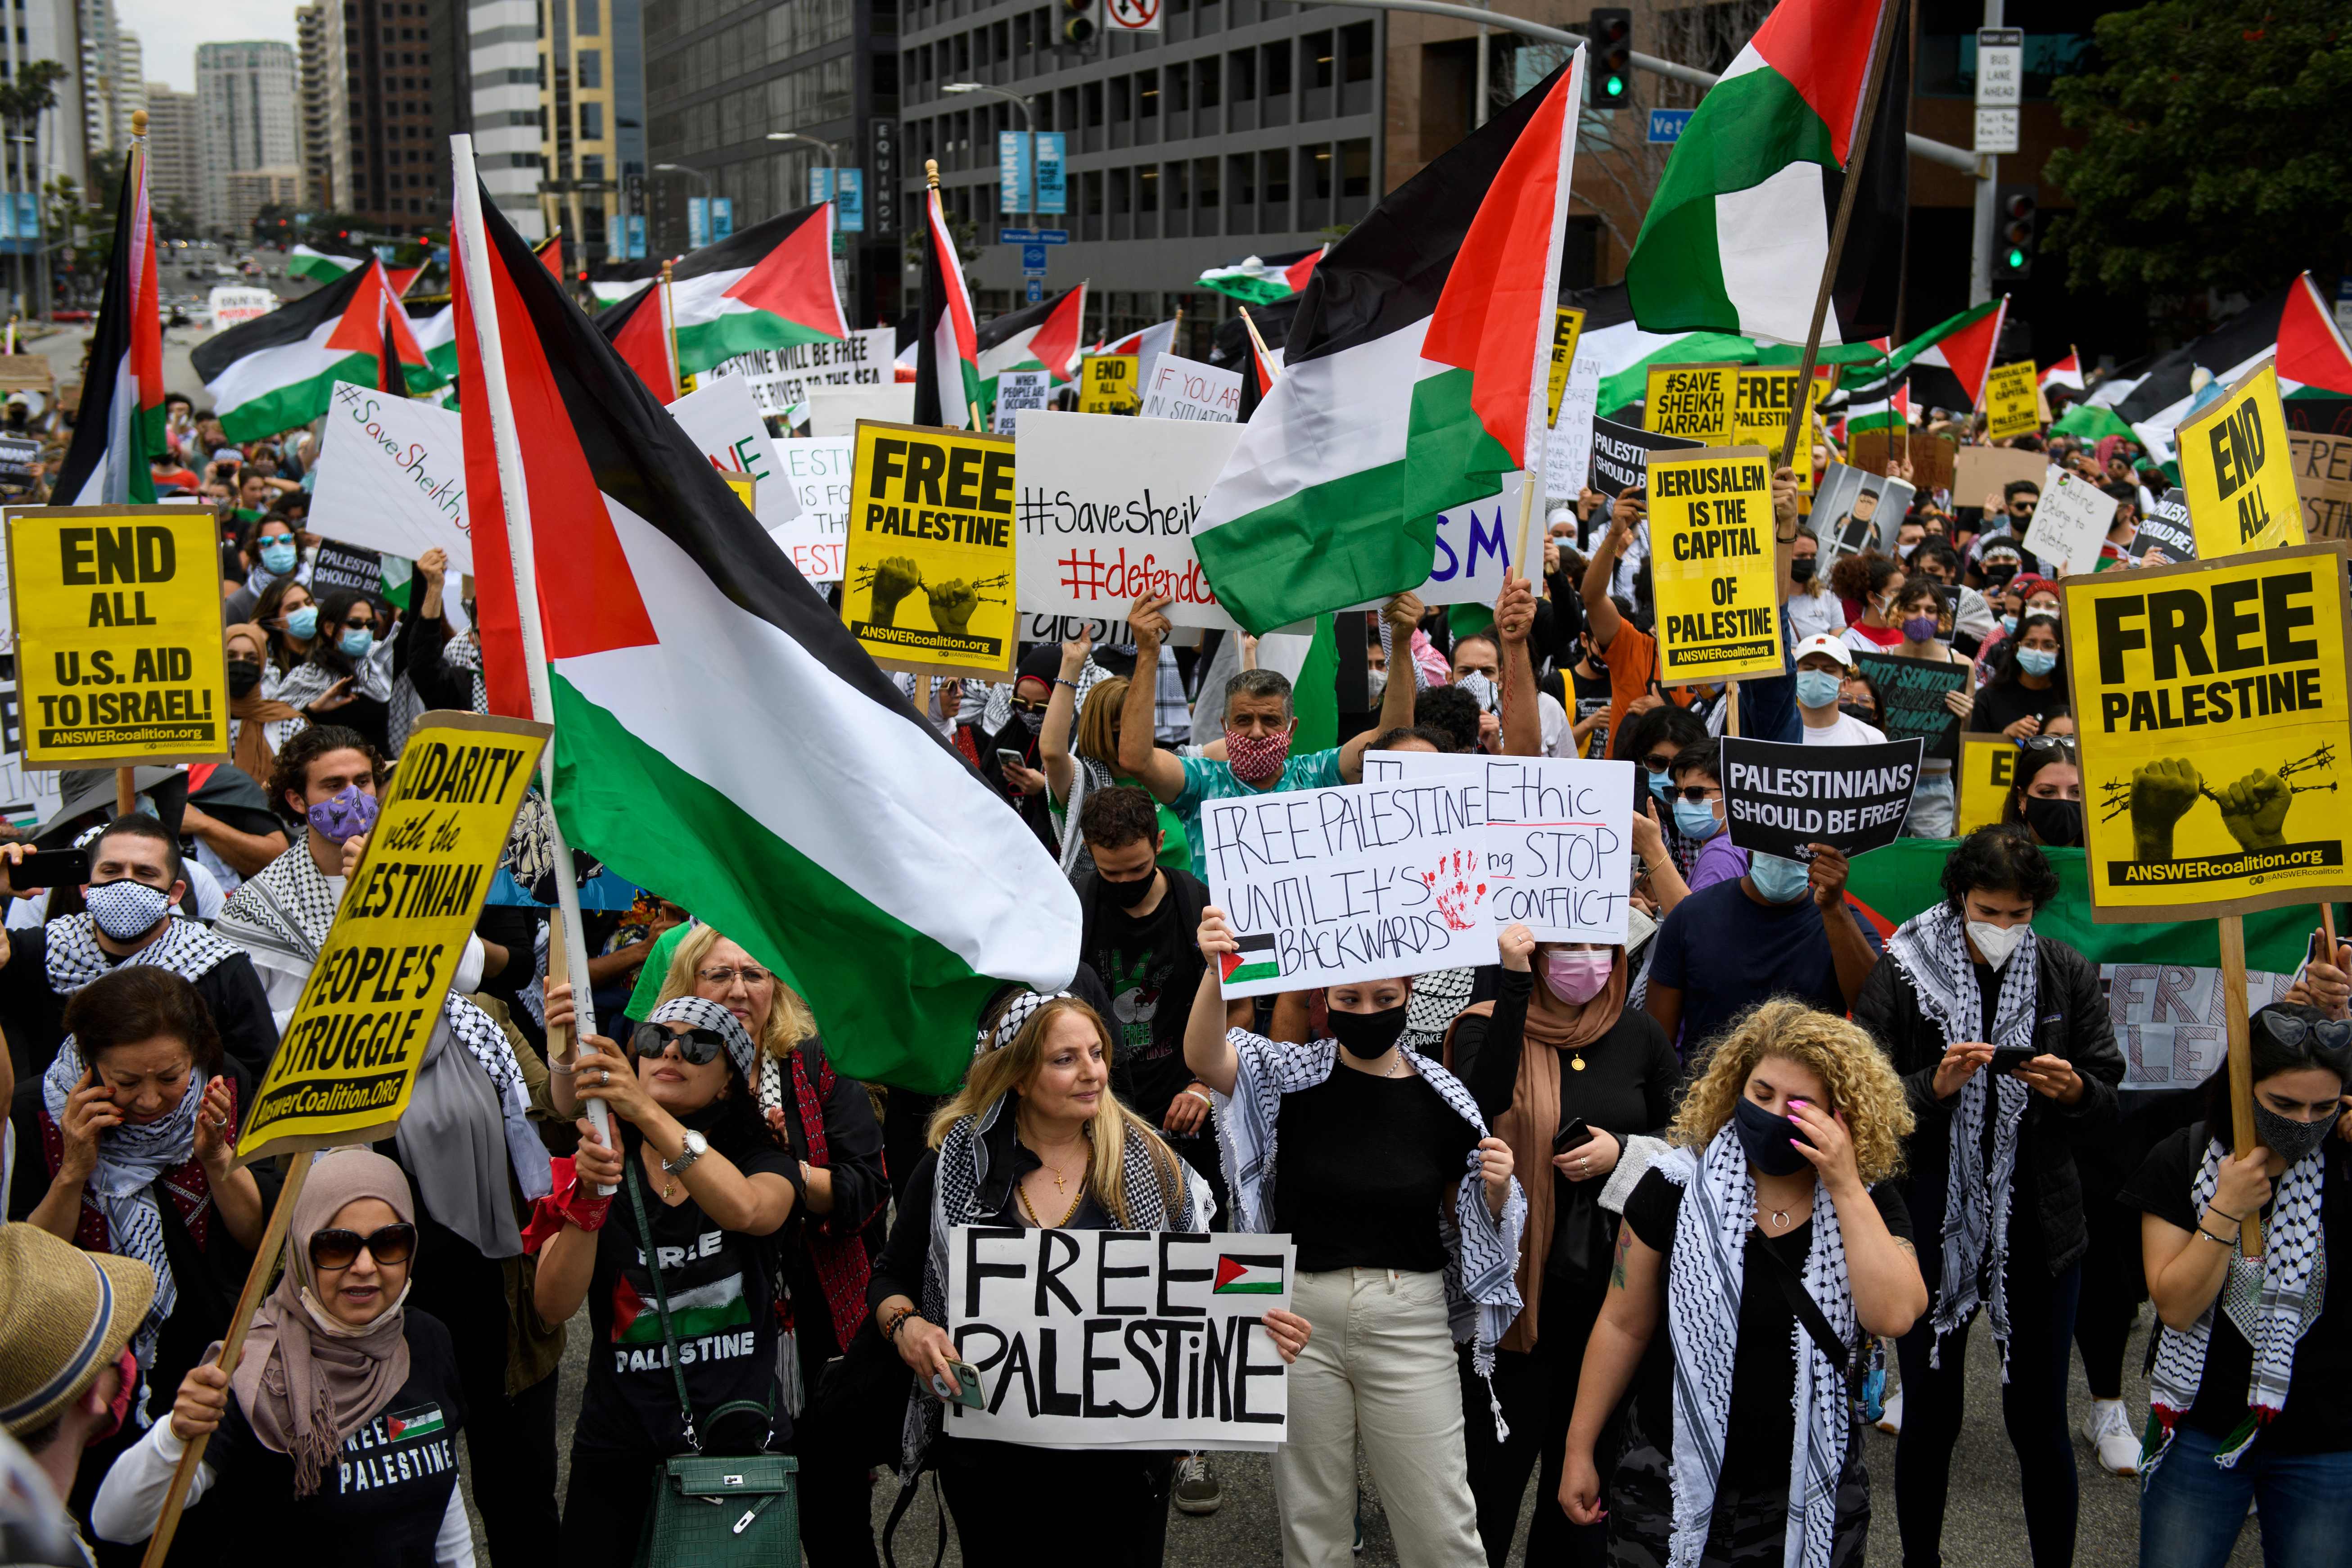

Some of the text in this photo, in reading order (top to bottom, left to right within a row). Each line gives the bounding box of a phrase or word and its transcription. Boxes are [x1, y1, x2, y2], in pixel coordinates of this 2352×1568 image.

[1986, 70, 2011, 81] LANE
[1990, 54, 2010, 65] BUS
[1984, 86, 2015, 97] AHEAD
[877, 124, 891, 232] EQUINOX
[1001, 134, 1019, 212] HAMMER
[776, 344, 809, 372] WILL
[813, 342, 830, 367] BE
[834, 336, 867, 363] FREE
[1096, 361, 1126, 380] END
[767, 377, 806, 407] RIVER
[1003, 386, 1045, 398] PEOPLE ARE
[1016, 375, 1037, 386] WHEN
[1099, 382, 1116, 394] ALL
[1156, 368, 1175, 390] IF
[1183, 373, 1216, 402] YOU
[1666, 372, 1722, 393] #SAVE
[1004, 398, 1041, 410] OCCUPIED
[1148, 394, 1165, 416] IN
[1657, 392, 1724, 414] SHEIKH
[1653, 413, 1724, 434] JARRAH
[2209, 396, 2266, 502] END
[870, 437, 1016, 515] FREE
[1596, 455, 1635, 486] SHOULD
[1656, 465, 1765, 498] JERUSALEM
[866, 503, 1010, 548] PALESTINE
[1688, 498, 1747, 527] IS THE
[2237, 483, 2271, 546] ALL
[60, 526, 176, 586] END
[1673, 527, 1761, 561] CAPITAL
[315, 567, 380, 593] SHOULD BE
[1711, 576, 1738, 606] OF
[88, 591, 157, 628] ALL
[1666, 607, 1773, 644] PALESTINE
[860, 625, 990, 653] ANSWERcoalition.org
[2095, 571, 2319, 685] FREE
[55, 647, 192, 686] U.S. AID
[1677, 645, 1769, 663] ANSWERcoalition.org
[38, 689, 212, 727] TO ISRAEL!
[2101, 668, 2323, 733] PALESTINE
[52, 728, 203, 745] ANSWERcoalition.org
[1486, 762, 1602, 823] Ethic
[1730, 762, 1912, 799] PALESTINIANS
[429, 810, 461, 854] the
[1211, 786, 1484, 881] FREE PALESTINE
[1731, 798, 1906, 834] SHOULD BE FREE
[1526, 827, 1619, 881] STOP
[2125, 848, 2323, 881] ANSWERcoalition.org
[2264, 868, 2344, 883] @ANSWERcoalition
[1227, 874, 1334, 933] UNTIL
[1279, 910, 1450, 977] BACKWARDS
[302, 944, 444, 1013] PEOPLE'S
[274, 1008, 424, 1083] STRUGGLE
[1122, 1023, 1151, 1046] FREE
[254, 1077, 401, 1129] AnswerCoalition.ORG
[965, 1228, 1214, 1318] FREE
[340, 1439, 453, 1494] PALESTINE
